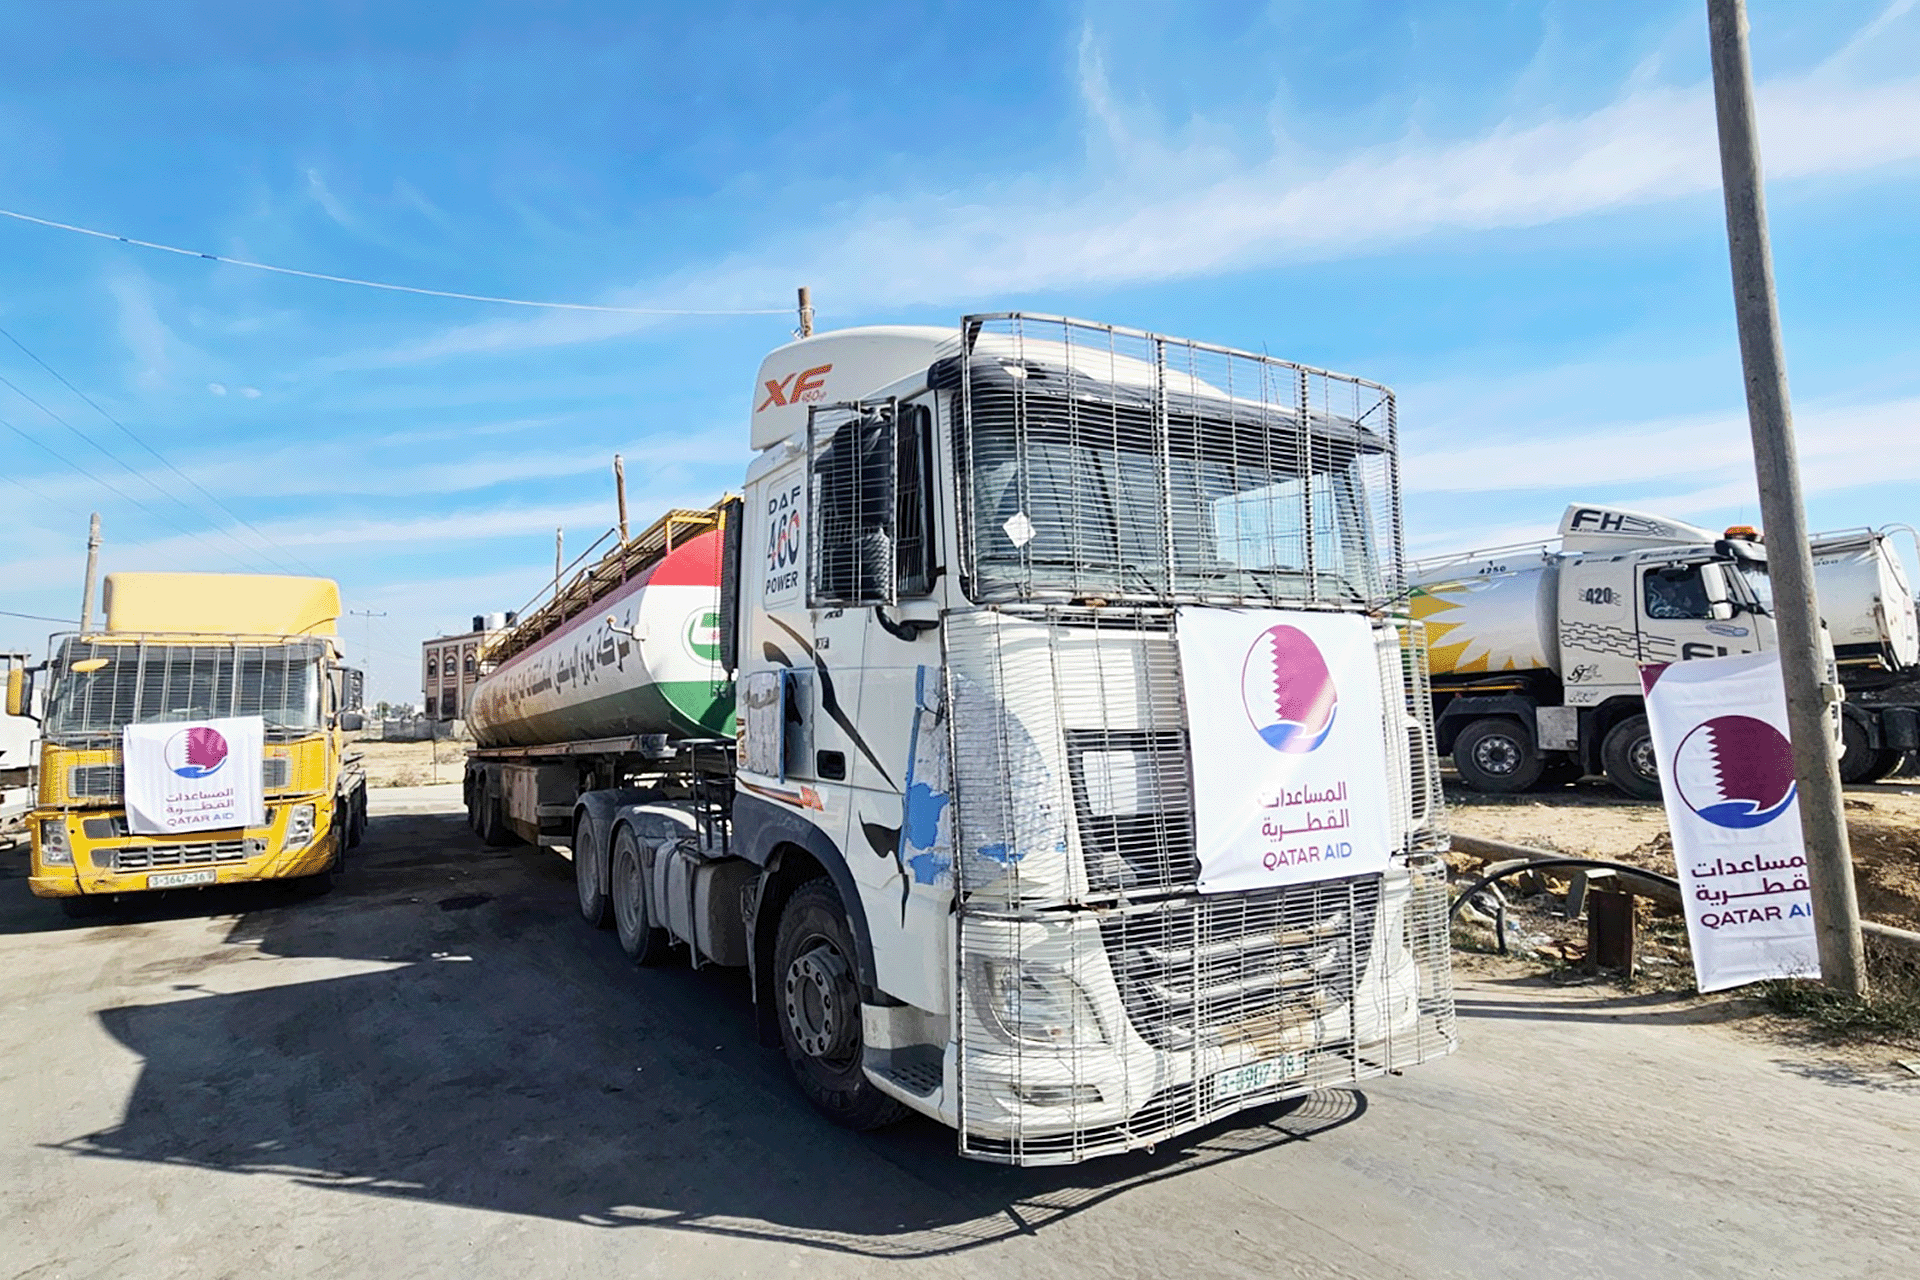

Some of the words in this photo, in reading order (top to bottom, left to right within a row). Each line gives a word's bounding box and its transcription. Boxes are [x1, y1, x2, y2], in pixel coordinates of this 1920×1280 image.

[757, 363, 833, 413] XF
[769, 485, 801, 516] DAF
[1571, 508, 1625, 531] FH
[767, 509, 801, 571] 460
[765, 570, 799, 596] POWER
[1585, 587, 1613, 605] 420
[166, 788, 234, 802] المساعدات
[1258, 781, 1348, 809] المساعدات
[167, 815, 210, 827] QATAR
[213, 812, 234, 821] AID
[1262, 808, 1350, 843] القطرية
[1263, 847, 1321, 871] QATAR
[1324, 842, 1353, 861] AID
[1691, 854, 1807, 878] مساعدات
[1695, 873, 1811, 906] قطرية
[1700, 906, 1783, 930] QATAR
[1788, 903, 1812, 919] AI
